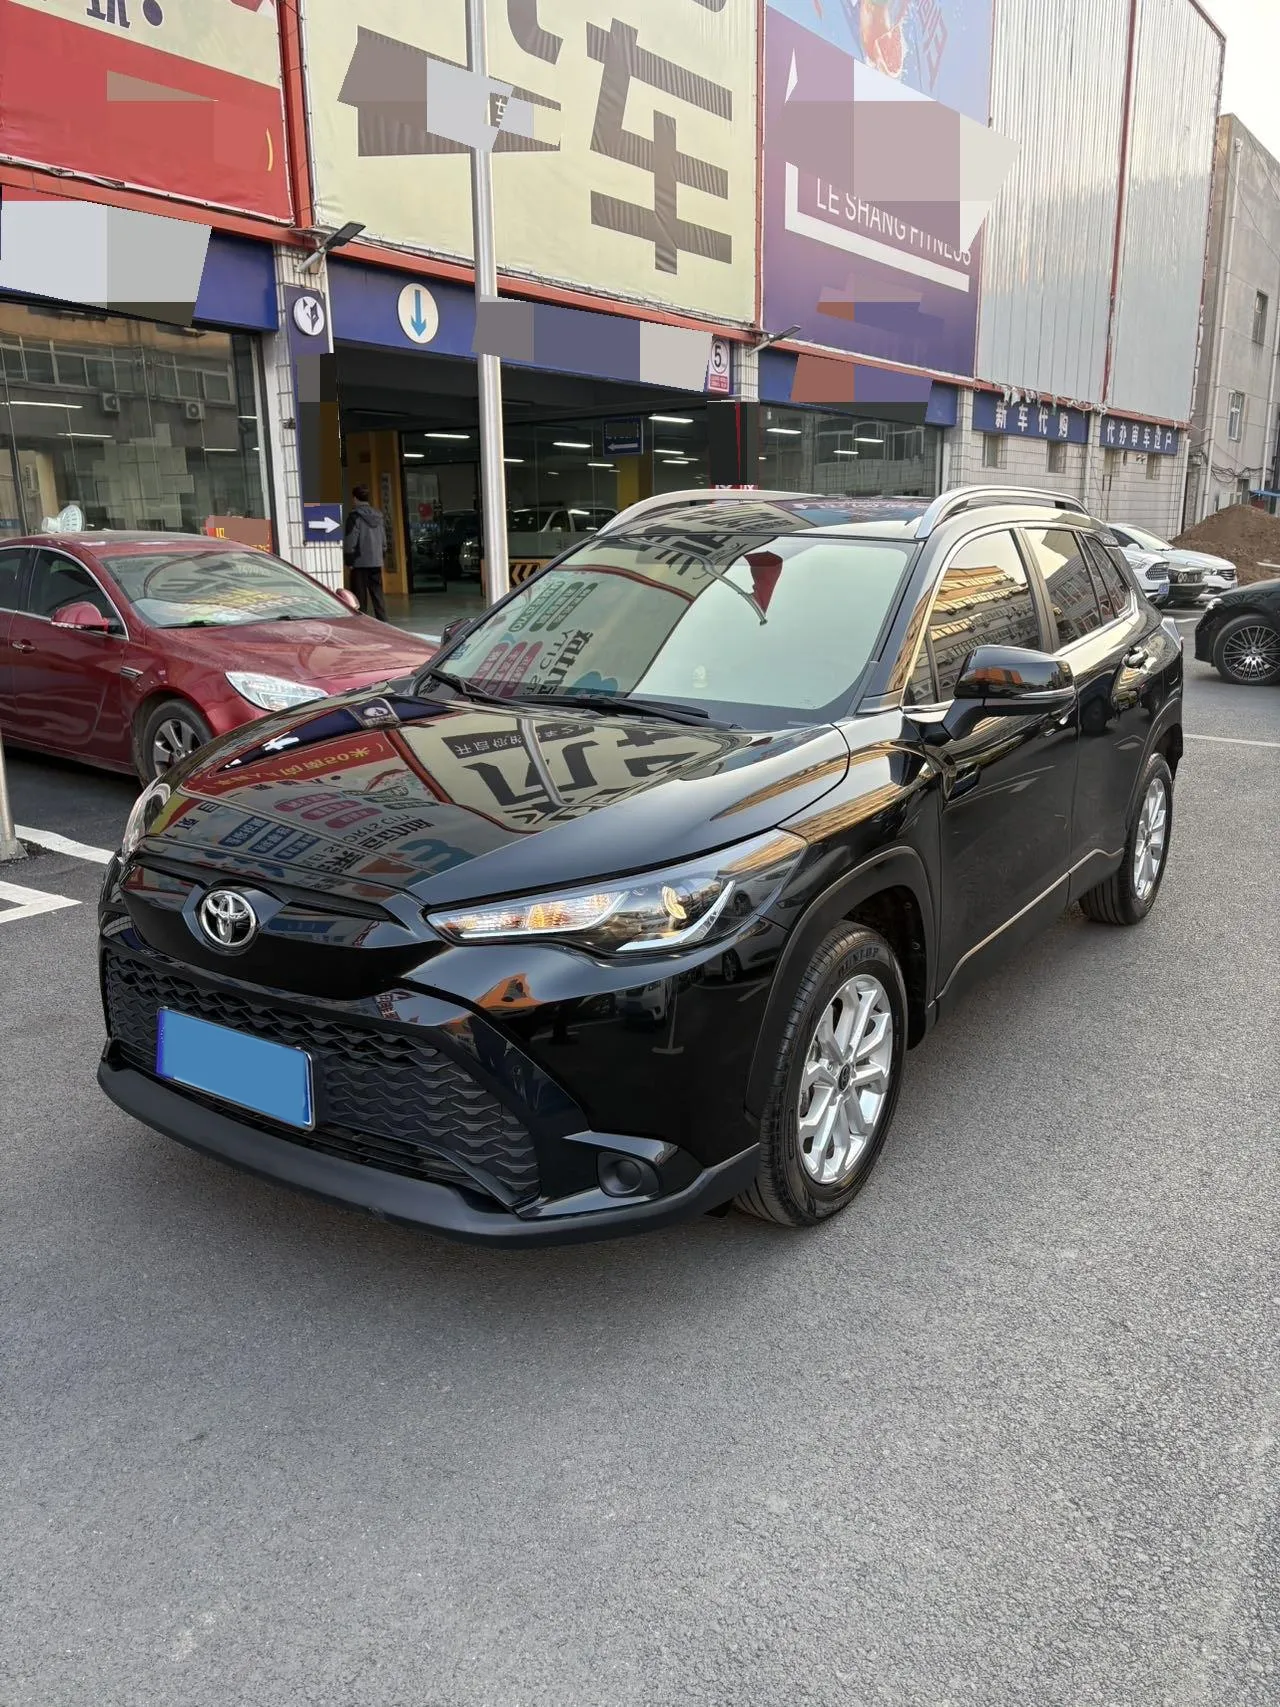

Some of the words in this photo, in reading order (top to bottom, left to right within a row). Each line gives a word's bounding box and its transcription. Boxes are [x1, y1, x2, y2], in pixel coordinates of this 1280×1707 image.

[816, 177, 840, 215] LE
[844, 192, 906, 240] SHANG
[713, 344, 722, 368] 5
[995, 401, 1069, 438] 新车代购
